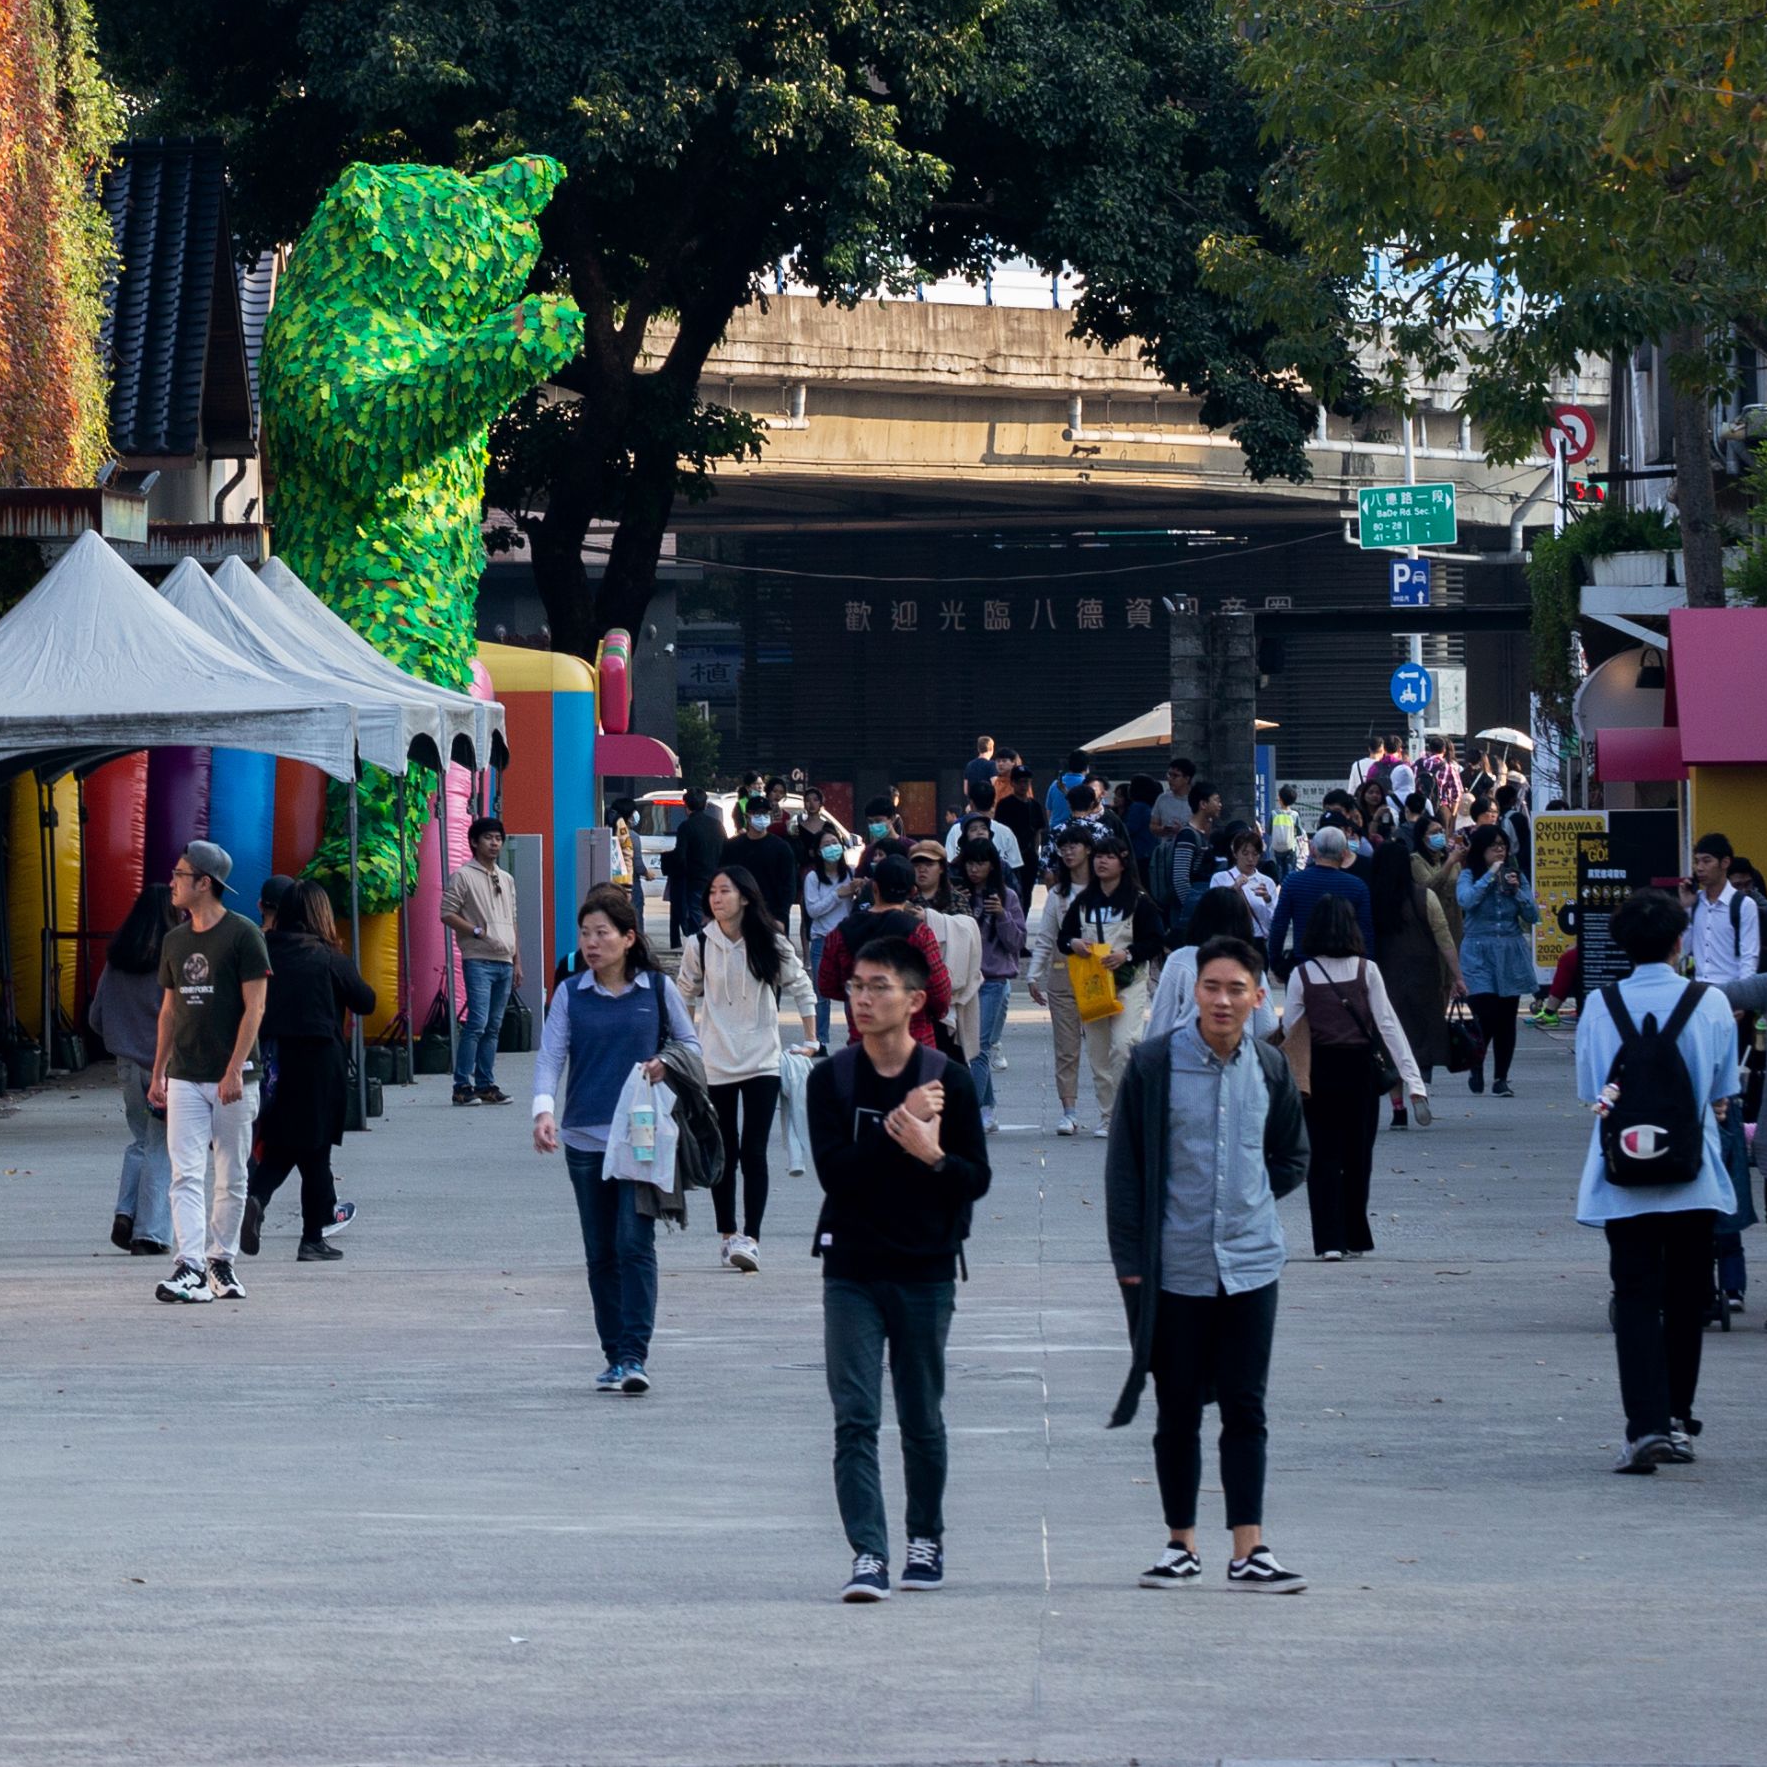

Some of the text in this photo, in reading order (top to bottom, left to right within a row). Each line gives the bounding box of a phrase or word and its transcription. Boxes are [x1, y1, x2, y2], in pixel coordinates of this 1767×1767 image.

[1370, 489, 1444, 507] 八德路一段
[1376, 509, 1398, 518] BaDe
[1400, 507, 1412, 517] Rd.
[1414, 506, 1430, 516] Sec.
[1393, 563, 1411, 593] P
[1535, 821, 1604, 832] OKINAWA &
[1535, 832, 1578, 842] KYOTO
